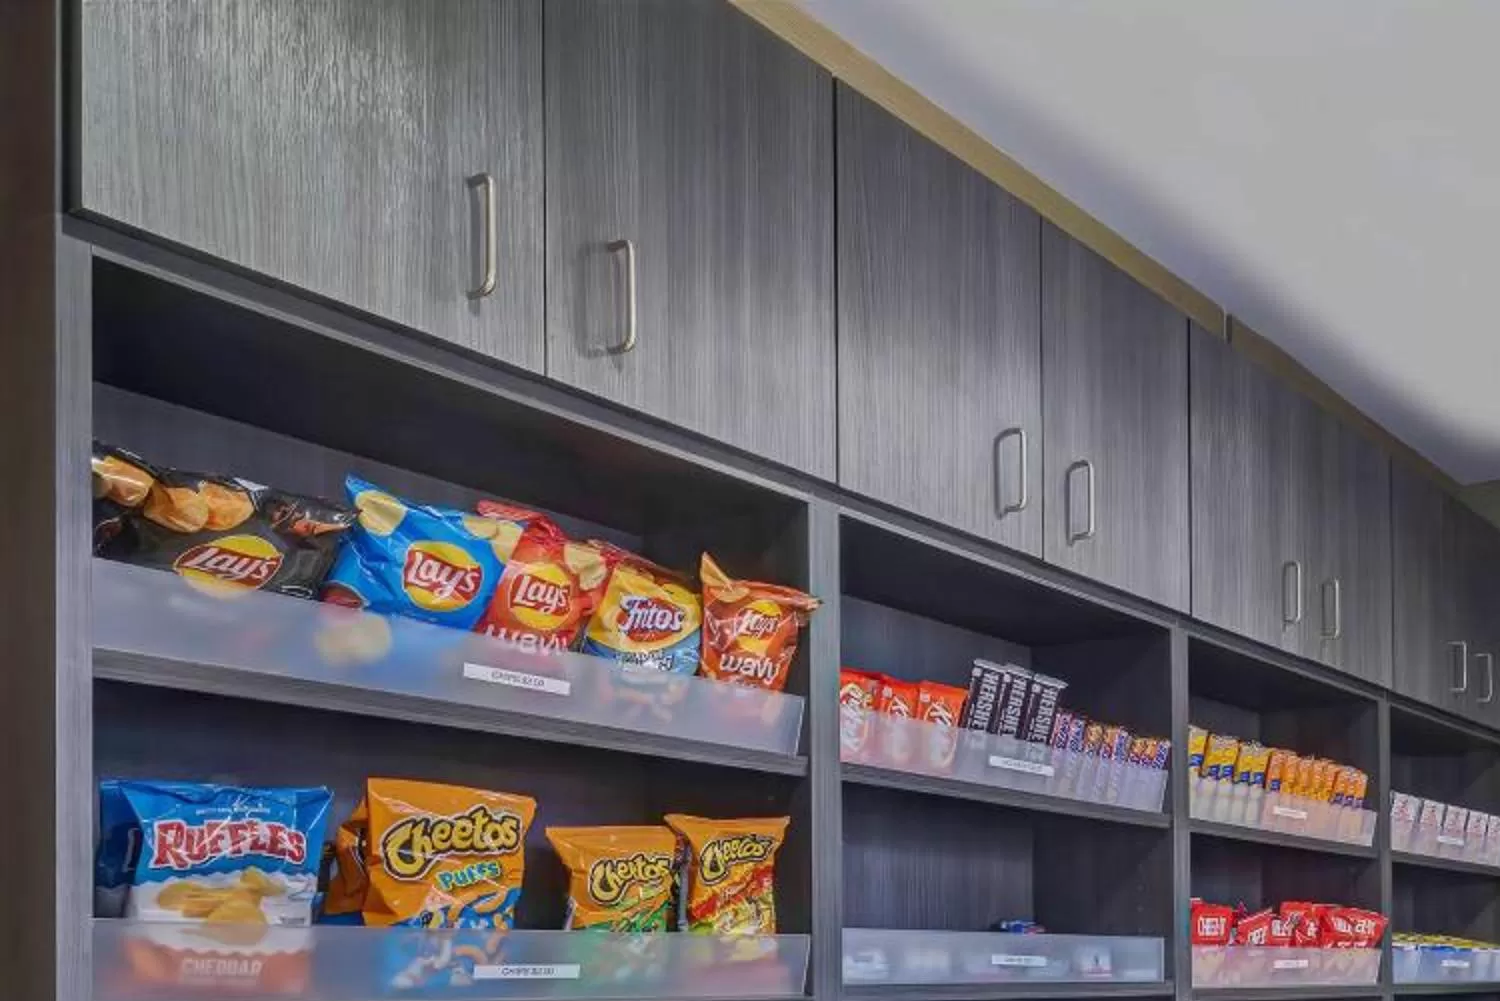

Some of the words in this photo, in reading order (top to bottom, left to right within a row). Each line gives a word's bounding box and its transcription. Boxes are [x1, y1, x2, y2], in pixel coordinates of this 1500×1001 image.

[188, 545, 277, 582] Lay's
[406, 552, 481, 598] Lay's
[514, 573, 569, 615] Lay's
[620, 593, 685, 634] Fritos
[734, 608, 780, 643] Lay's
[151, 820, 307, 870] RUFFLES
[382, 805, 522, 880] Cheetos
[699, 835, 774, 885] Cheetos
[590, 854, 673, 905] Cheetos
